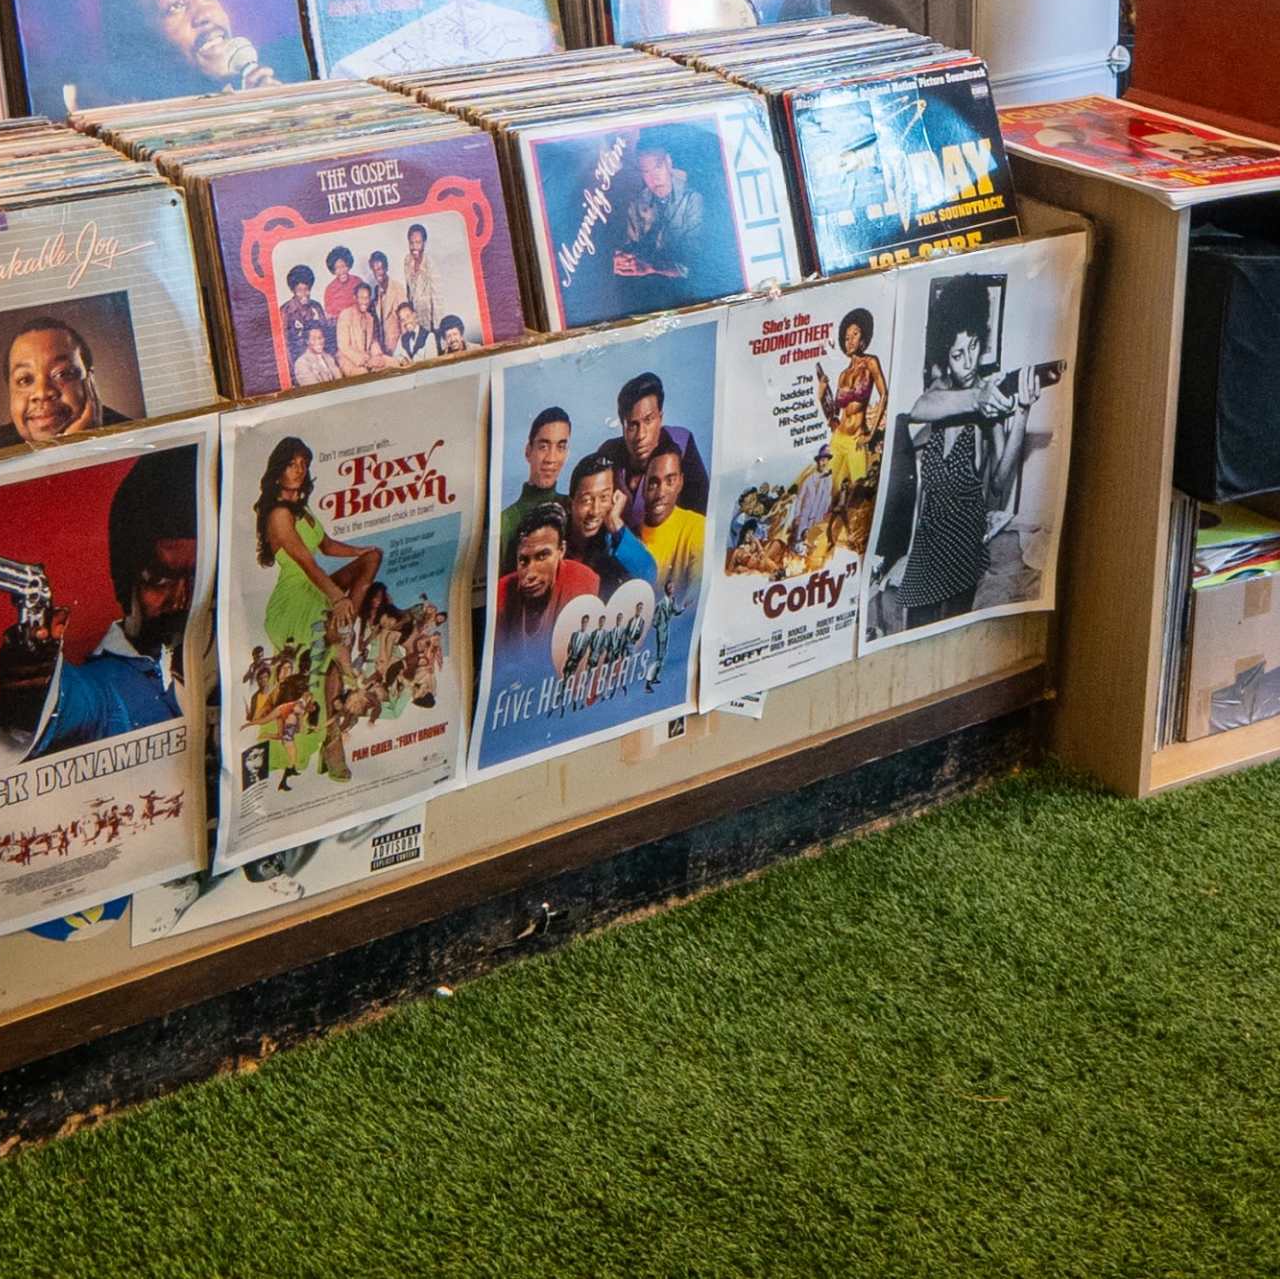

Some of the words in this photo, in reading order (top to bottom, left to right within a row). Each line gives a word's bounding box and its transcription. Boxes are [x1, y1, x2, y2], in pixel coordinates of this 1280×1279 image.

[918, 74, 945, 88] Picture
[945, 66, 987, 84] Soundtrack
[316, 163, 348, 192] THE
[350, 158, 404, 186] GOSPEL
[327, 182, 401, 215] KEYNOTES
[557, 186, 613, 288] Magnify
[595, 136, 628, 192] Him
[916, 210, 939, 227] THE
[939, 194, 1005, 222] SOUNDTRACK
[67, 219, 156, 289] Joy
[762, 317, 791, 336] She's
[793, 312, 810, 328] the
[779, 349, 792, 366] of
[780, 386, 814, 402] baddest
[338, 439, 445, 487] Foxy
[318, 468, 457, 521] Brown
[491, 686, 536, 731] FIVE
[536, 649, 651, 716] HEARTBEATS
[35, 725, 187, 796] DYNAMITE
[351, 746, 370, 762] PAM
[372, 833, 419, 860] ADVISORY
